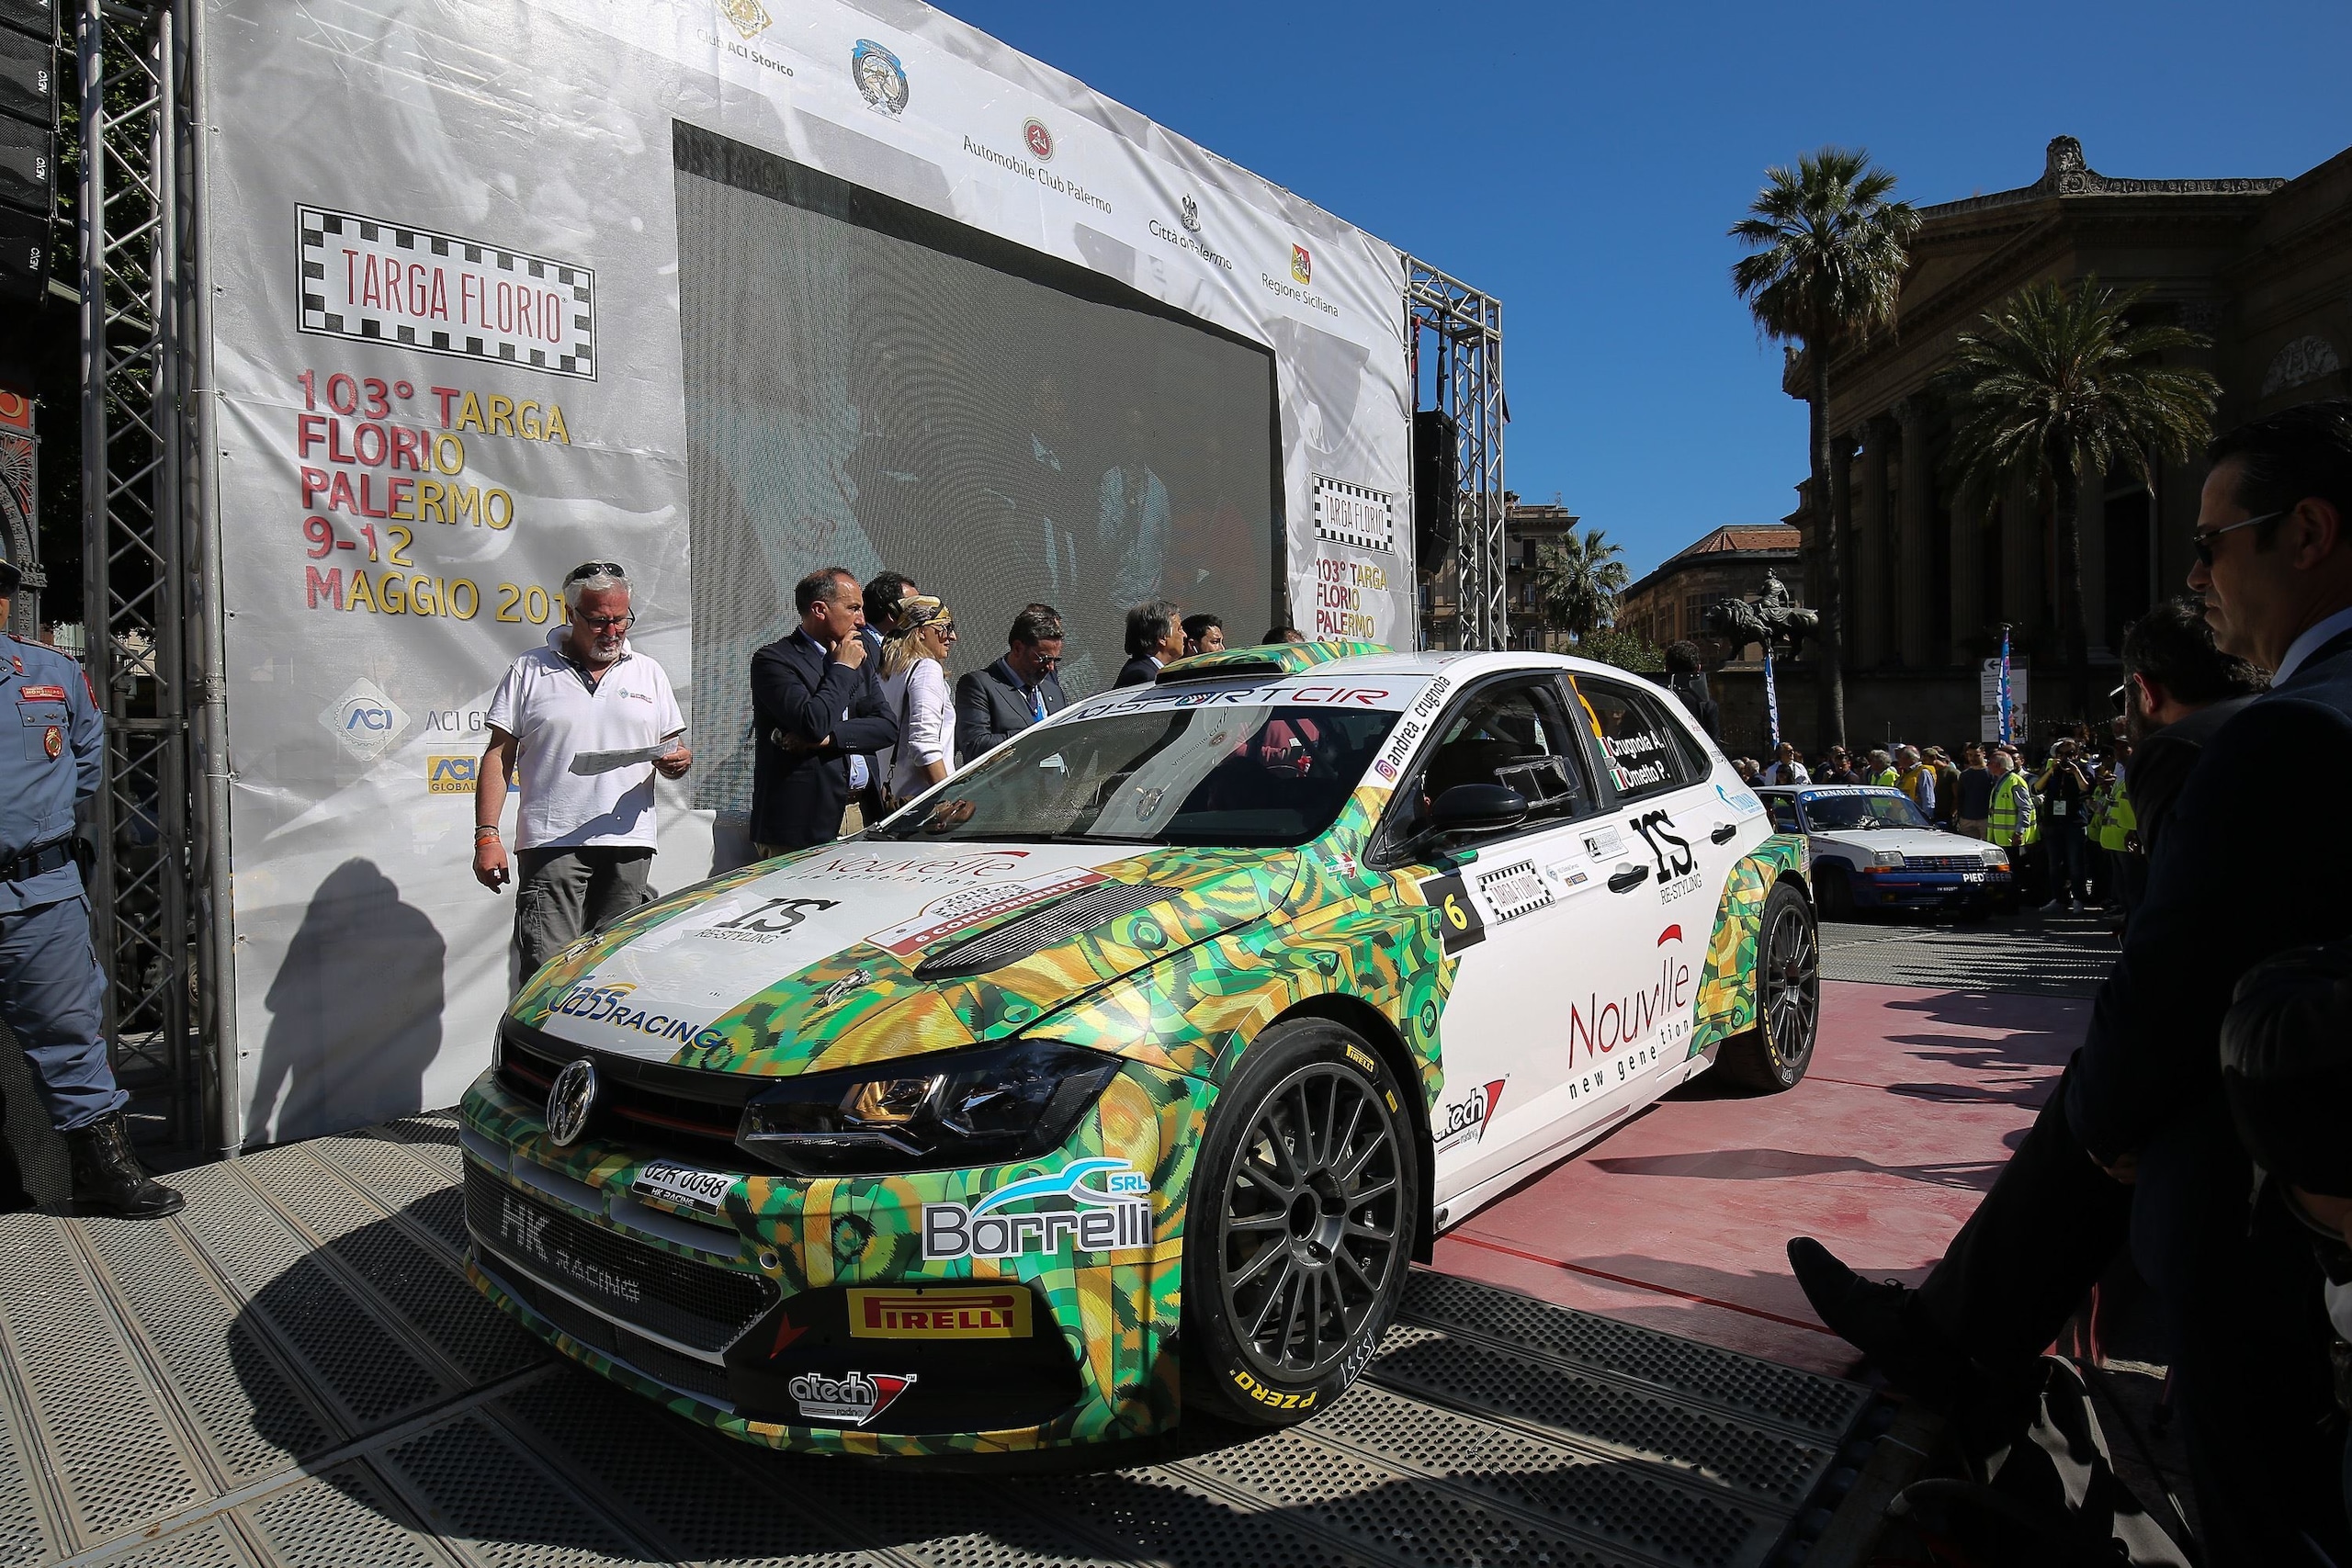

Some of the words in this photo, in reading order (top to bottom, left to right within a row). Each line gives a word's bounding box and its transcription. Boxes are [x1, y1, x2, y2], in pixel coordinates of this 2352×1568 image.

[697, 28, 723, 48] Club
[728, 41, 748, 59] ACI
[752, 51, 794, 77] Storico
[964, 135, 1035, 180] Automobile
[1038, 168, 1065, 193] Club
[1067, 180, 1112, 214] Palermo
[1148, 220, 1178, 245] Città
[1189, 238, 1233, 270] Palermo
[341, 248, 449, 321] TARGA
[460, 272, 562, 344] FLORIO
[1261, 273, 1301, 301] Regione
[1303, 290, 1339, 318] Siciliana
[298, 368, 413, 420] 103°
[431, 386, 571, 445] TARGA
[298, 414, 465, 476] FLORIO
[300, 466, 514, 530] PALERMO
[1325, 495, 1353, 528] TARGA
[1355, 503, 1384, 536] FLORIO
[303, 515, 413, 567] 9-12
[1317, 558, 1346, 583] 103°
[1351, 563, 1388, 592] TARGA
[305, 566, 480, 621] MAGGIO
[1317, 582, 1361, 612] FLORIO
[1317, 610, 1374, 639] PALERMO
[1292, 687, 1390, 705] CIR
[347, 708, 394, 729] ACI
[425, 710, 459, 731] ACI
[1607, 732, 1654, 760] Crugnola
[1650, 730, 1665, 749] A.
[432, 759, 476, 781] ACI
[1622, 763, 1659, 788] Ometto
[1654, 761, 1670, 780] P.
[432, 783, 477, 791] GLOBAL
[1815, 789, 1863, 798] RENAULT
[944, 886, 989, 904] 2019
[1489, 882, 1521, 908] TARGA
[1511, 874, 1542, 901] FLORIO
[1660, 874, 1702, 905] RE-STYLING
[915, 934, 931, 943] 6
[933, 879, 1086, 935] CONCORRENTE
[1443, 893, 1468, 931] 6
[694, 929, 781, 944] RE-STYLING
[1346, 1043, 1375, 1073] PIRELLI
[1568, 1069, 1603, 1100] new
[651, 1188, 663, 1198] HK
[680, 1171, 728, 1199] 0098
[1111, 1174, 1148, 1192] SRL
[501, 1195, 550, 1263] HK
[924, 1203, 1151, 1259] Borrelli
[863, 1295, 1015, 1329] PIRELLI
[790, 1374, 870, 1404] atech
[1234, 1371, 1317, 1409] PZERO
[836, 1407, 865, 1419] racing
